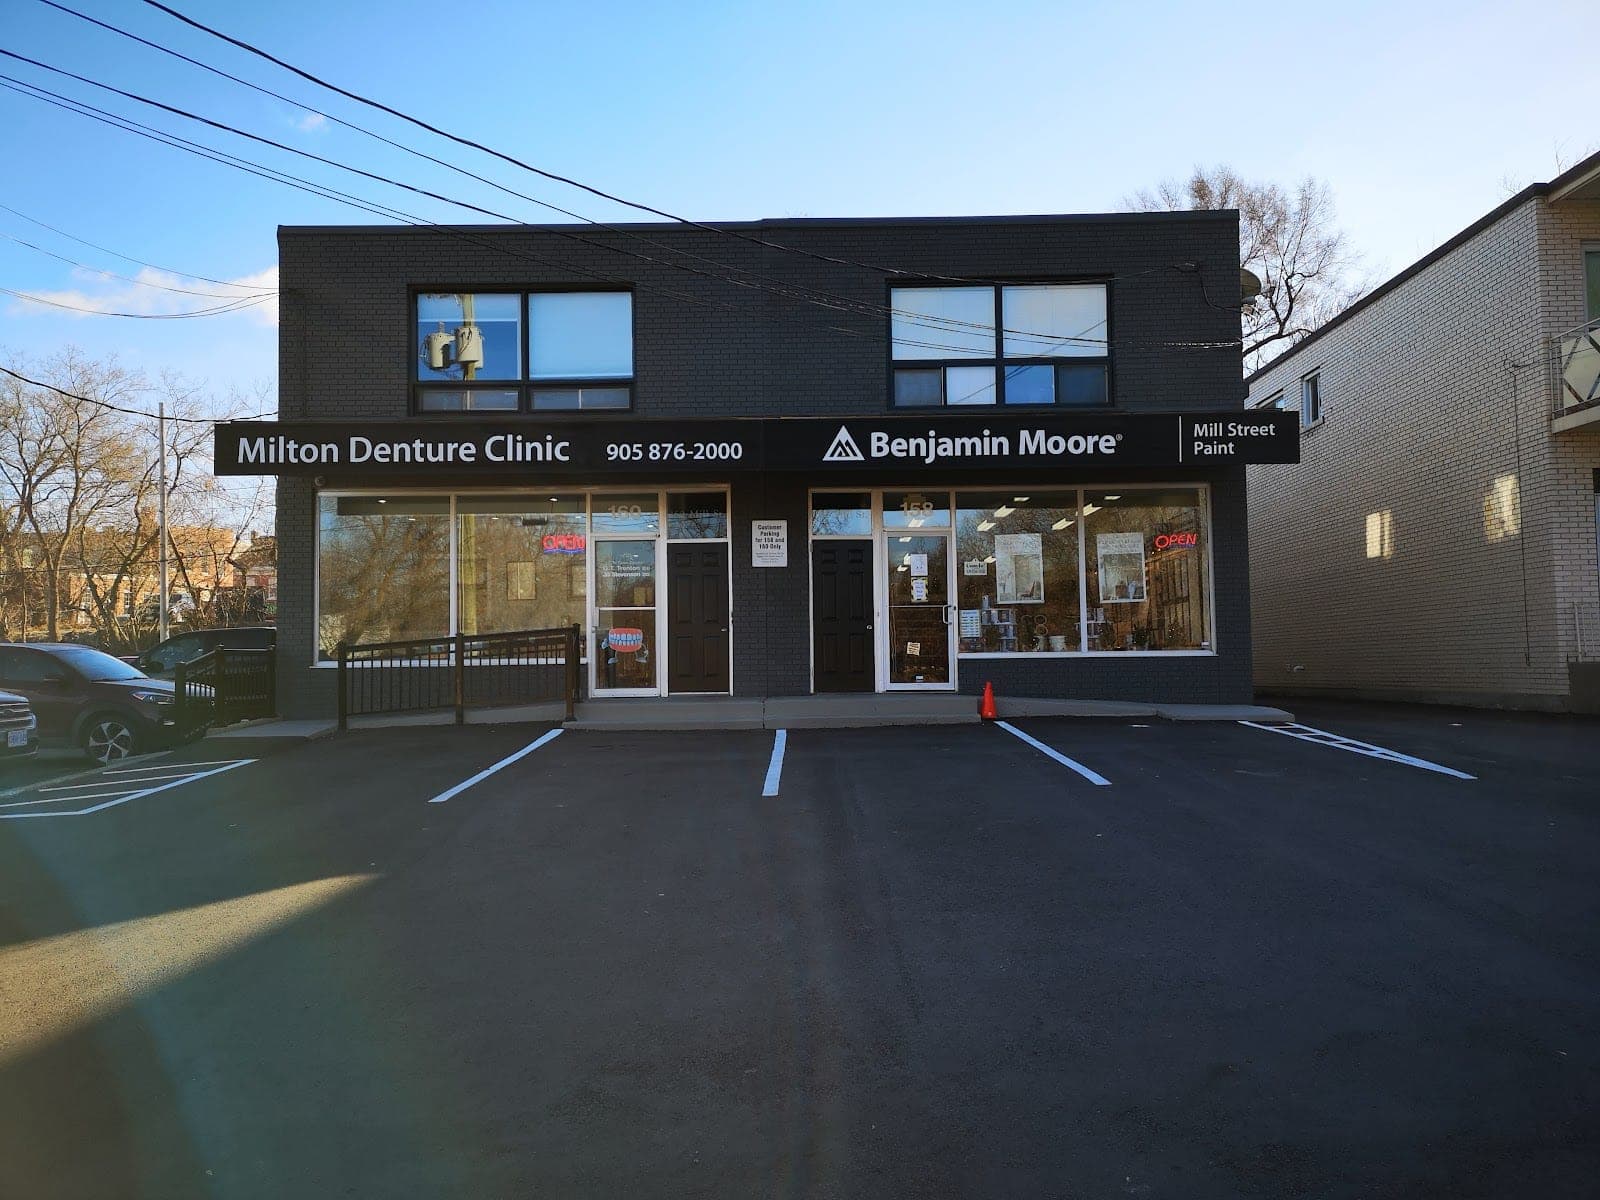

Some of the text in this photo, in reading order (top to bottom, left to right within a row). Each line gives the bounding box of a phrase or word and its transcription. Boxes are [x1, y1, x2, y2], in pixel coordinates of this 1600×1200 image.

[1193, 422, 1276, 437] Mill Street
[237, 434, 570, 464] Milton Denture Clinic
[606, 442, 743, 461] 905 876-2000
[870, 428, 1010, 465] Benjamin
[1194, 440, 1235, 455] Paint
[608, 504, 642, 520] 160
[900, 501, 934, 516] 158
[543, 534, 586, 550] OPEN
[1155, 533, 1197, 548] OPEN
